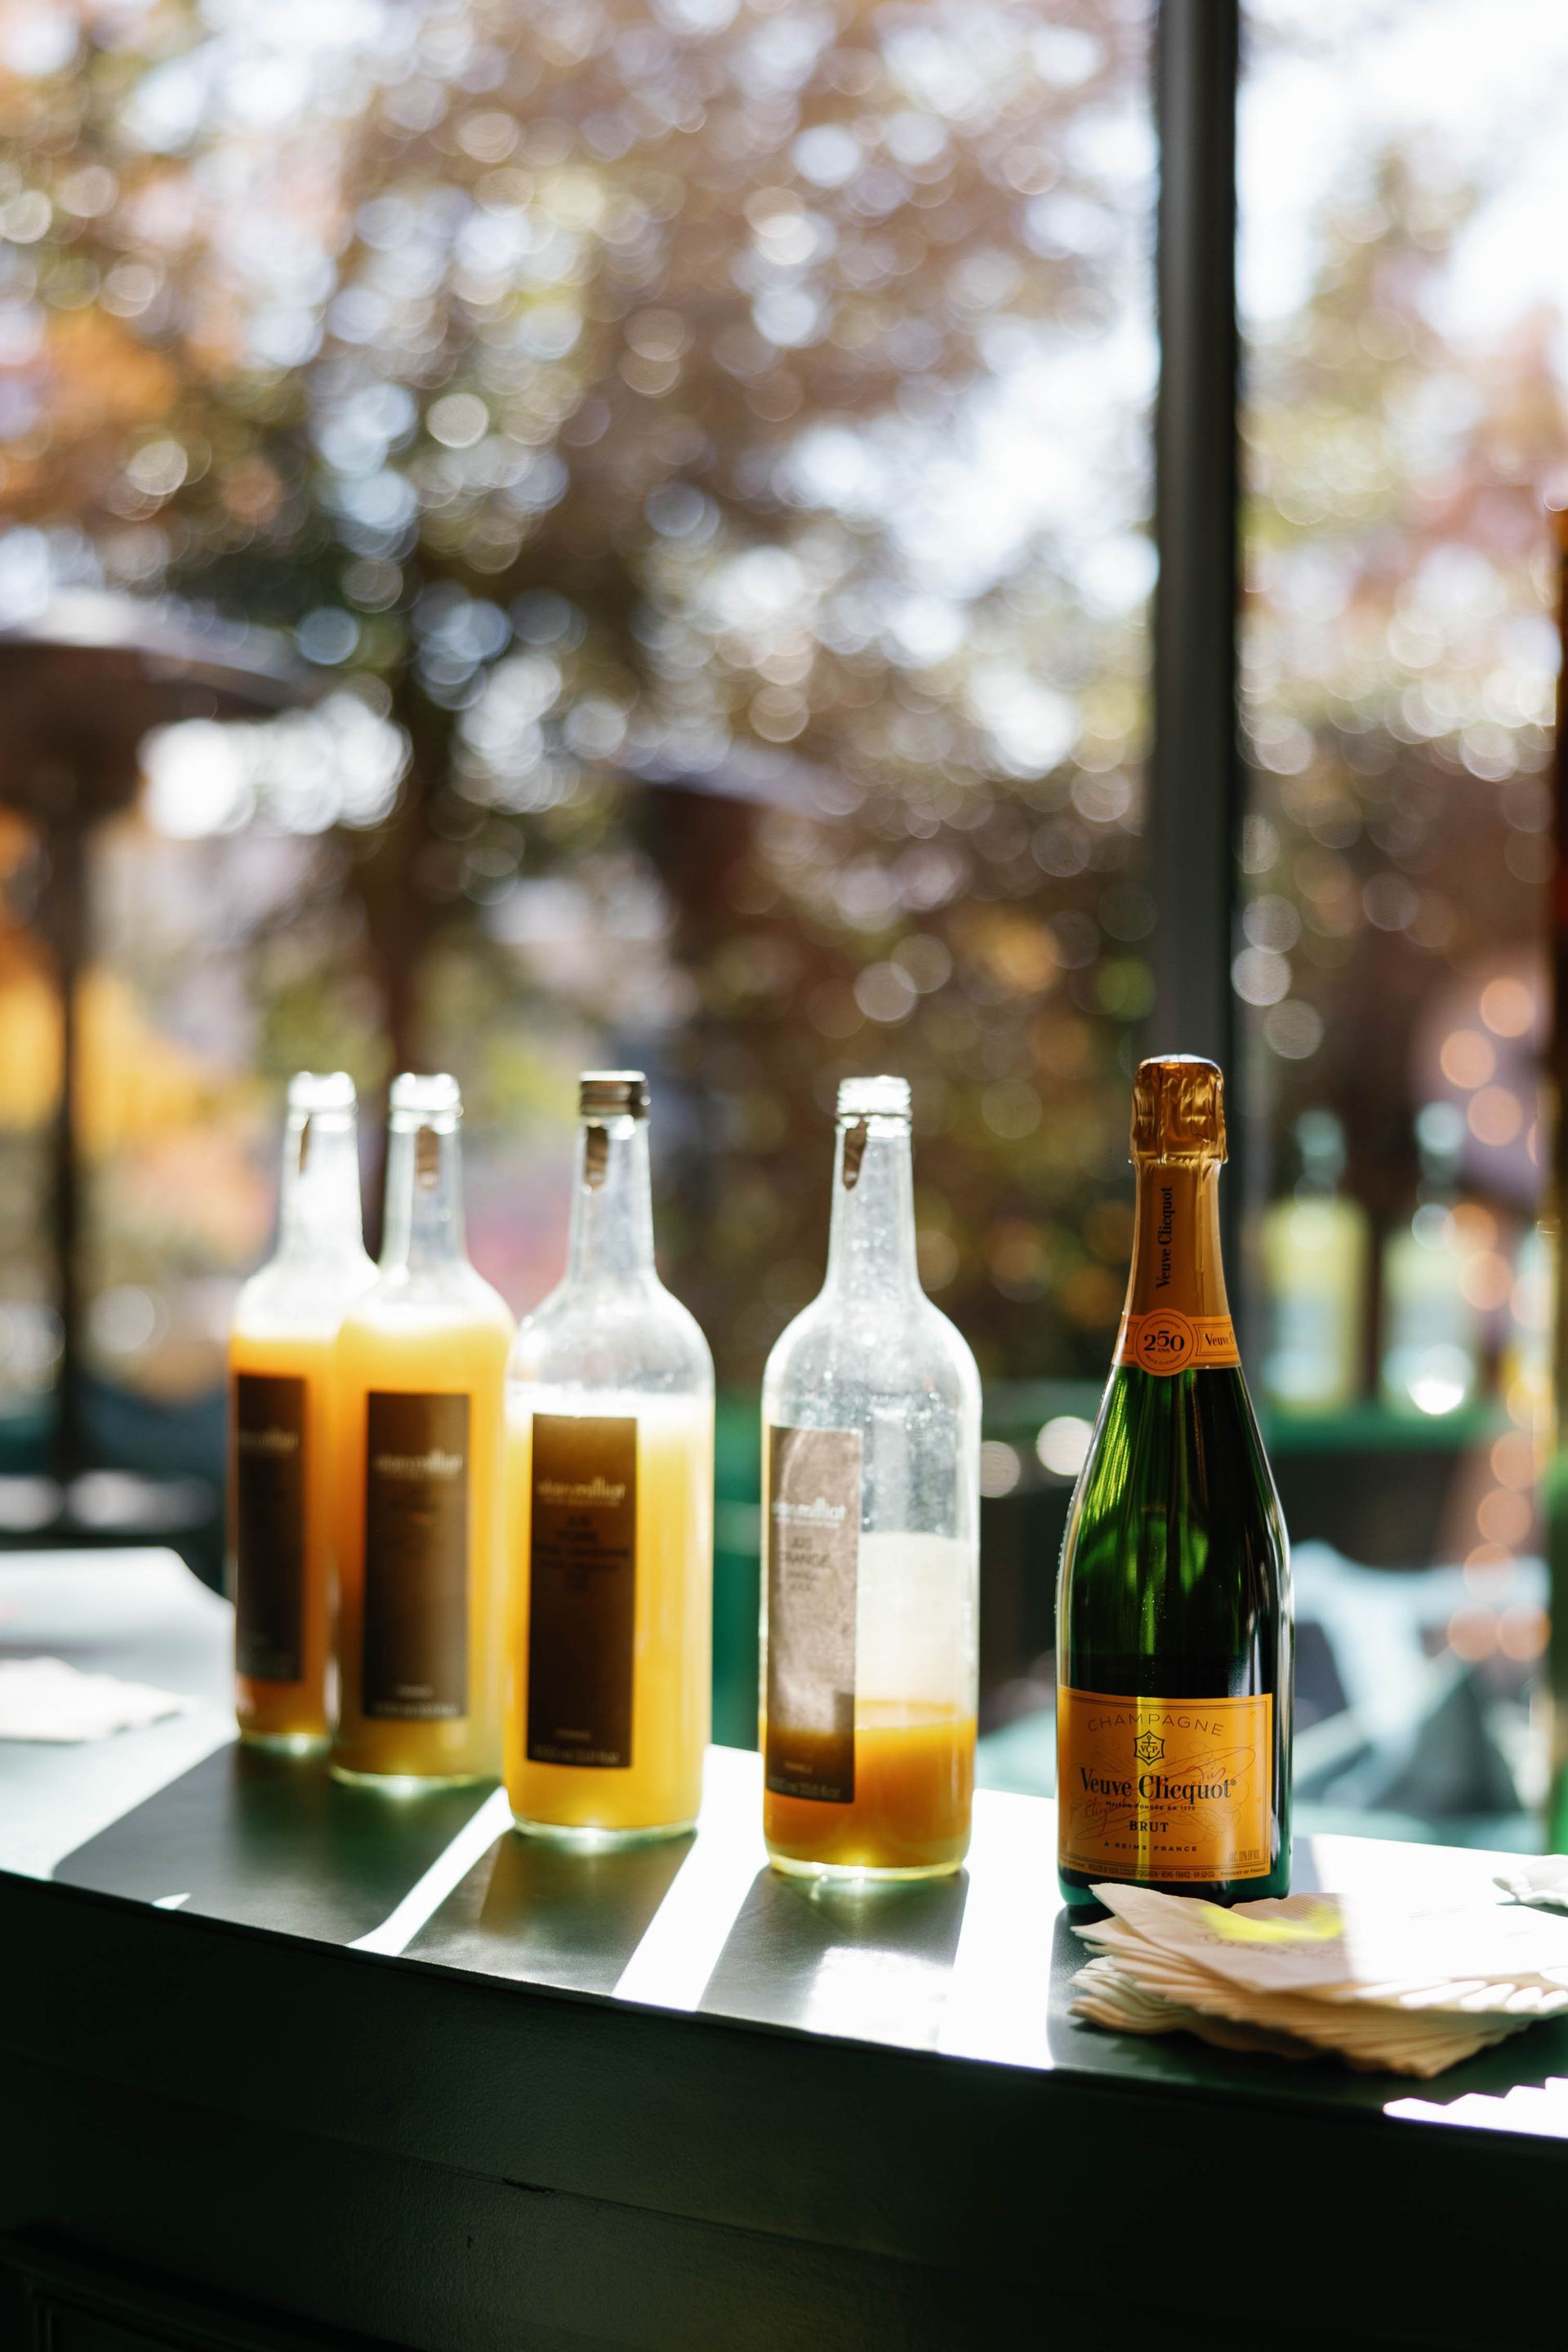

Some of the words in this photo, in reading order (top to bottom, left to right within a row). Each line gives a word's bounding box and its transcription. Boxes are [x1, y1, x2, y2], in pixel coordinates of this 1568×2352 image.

[1157, 1187, 1176, 1245] Clicquot
[1156, 1249, 1171, 1289] Veuve
[1143, 1330, 1185, 1352] 250
[1205, 1333, 1230, 1346] Veuve
[1088, 1713, 1224, 1737] CHAMPAGNE
[1140, 1745, 1158, 1754] VCP
[1080, 1766, 1133, 1797] Veuve
[1129, 1820, 1169, 1833] BRUT
[1115, 1842, 1147, 1851] REIMS
